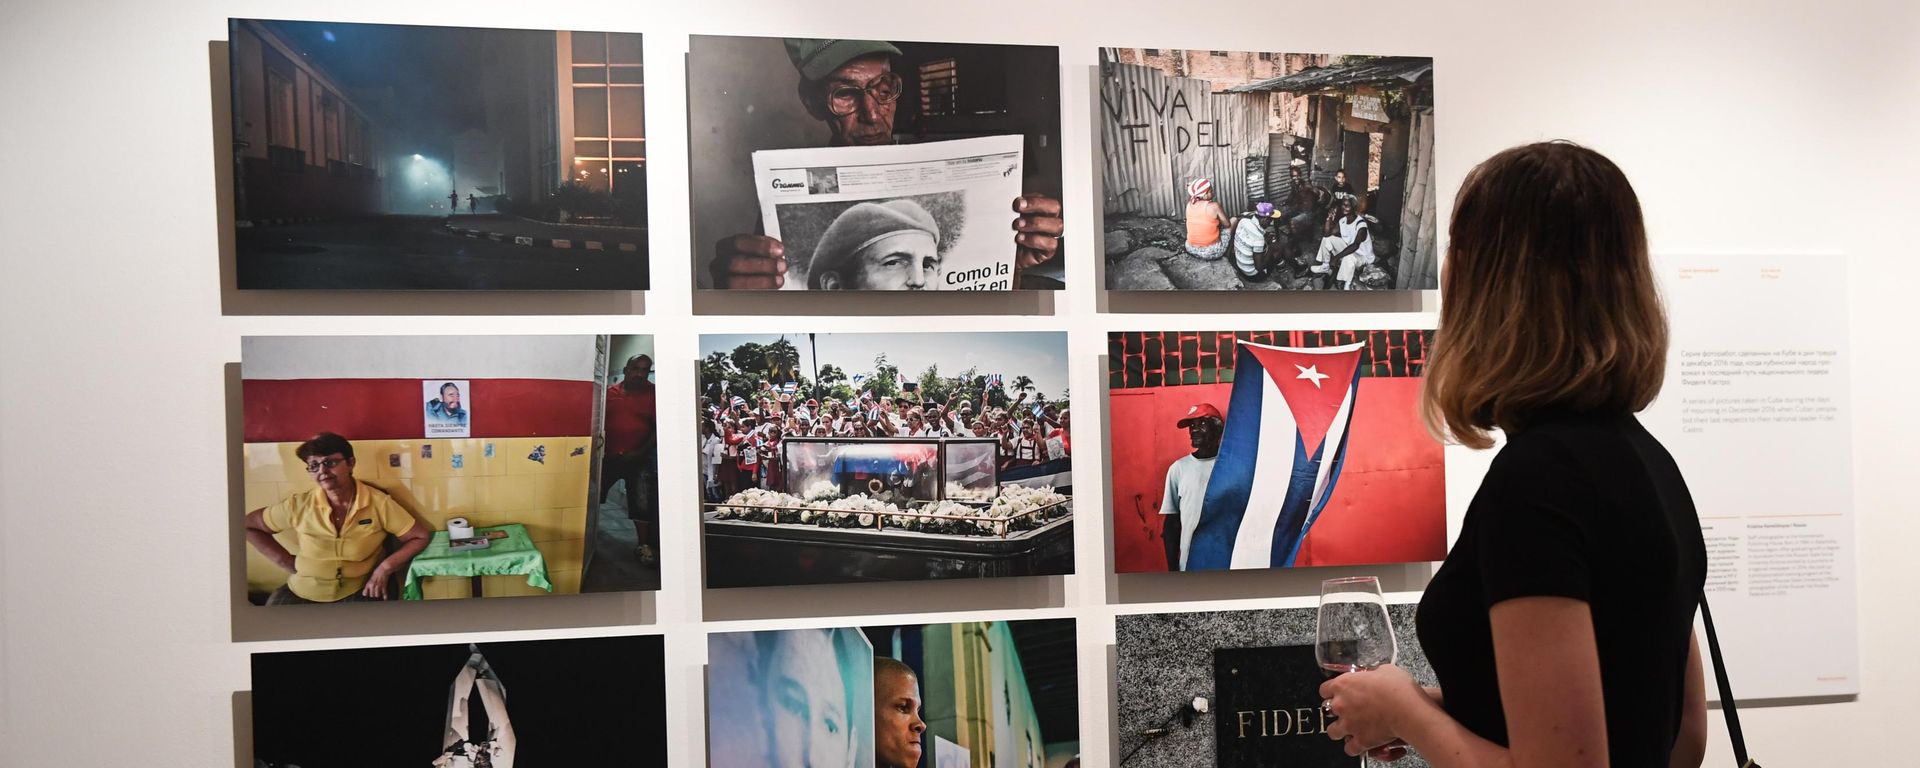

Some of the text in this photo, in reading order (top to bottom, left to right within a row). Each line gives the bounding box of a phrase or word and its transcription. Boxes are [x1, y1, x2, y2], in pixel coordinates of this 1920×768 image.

[946, 261, 1009, 285] Como la
[990, 279, 1008, 291] en
[1236, 706, 1328, 738] FIDEL
